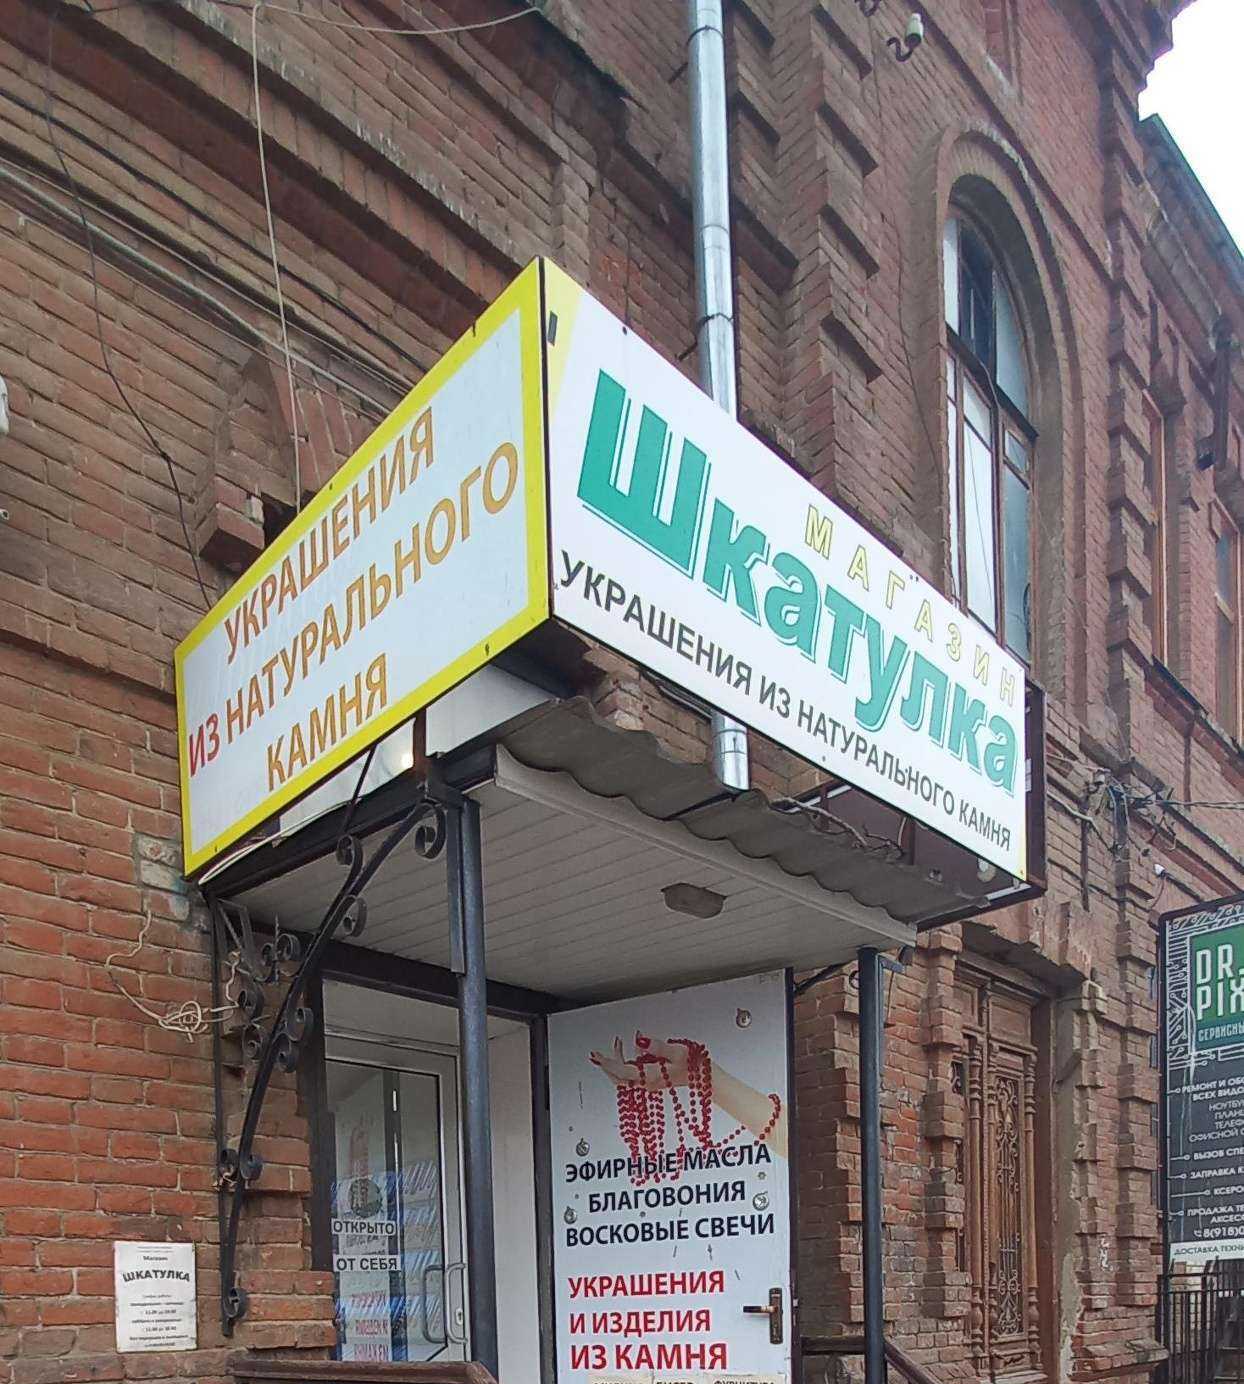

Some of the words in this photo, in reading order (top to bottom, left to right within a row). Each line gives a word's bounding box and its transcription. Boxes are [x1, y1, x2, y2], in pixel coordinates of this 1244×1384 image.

[224, 405, 435, 664] УКРАШЕНИЯ
[576, 368, 1021, 798] Шкатулка
[189, 712, 221, 778] ИЗ
[226, 441, 519, 745] НАТУРАЛЬНОГО
[803, 504, 1016, 709] МАГАЗИН
[560, 550, 753, 699] УКРАШЕНИЯ
[758, 681, 792, 720] ИЗ
[797, 699, 956, 817] НАТУРАЛЬНОГО
[959, 803, 1011, 852] КАМНЯ
[266, 653, 389, 793] КАМНЯ
[1182, 1081, 1218, 1093] РЕМОНТ
[1219, 1079, 1226, 1088] И
[1192, 1090, 1216, 1101] ВСЕХ
[565, 1152, 678, 1183] ЭФИРНЫЕ
[683, 1143, 771, 1171] МАСЛА
[1193, 1149, 1225, 1160] ВЫЗОВ
[1190, 1167, 1236, 1179] ЗАПРАВКА
[588, 1180, 746, 1213] БЛАГОВОНИЯ
[1187, 1205, 1234, 1217] ПРОДАЖА
[333, 1220, 395, 1235] ОТКРЫТО
[566, 1219, 689, 1247] ВОСКОВЫЕ
[695, 1213, 775, 1238] СВЕЧИ
[123, 1269, 190, 1282] ШКАТУЛКА
[336, 1258, 356, 1271] ОТ
[360, 1258, 398, 1271] СЕБЯ
[568, 1270, 725, 1299] УКРАШЕНИЯ
[569, 1312, 586, 1335] И
[592, 1309, 711, 1338] ИЗДЕЛИЯ
[570, 1344, 607, 1370] ИЗ
[615, 1342, 727, 1370] КАМНЯ
